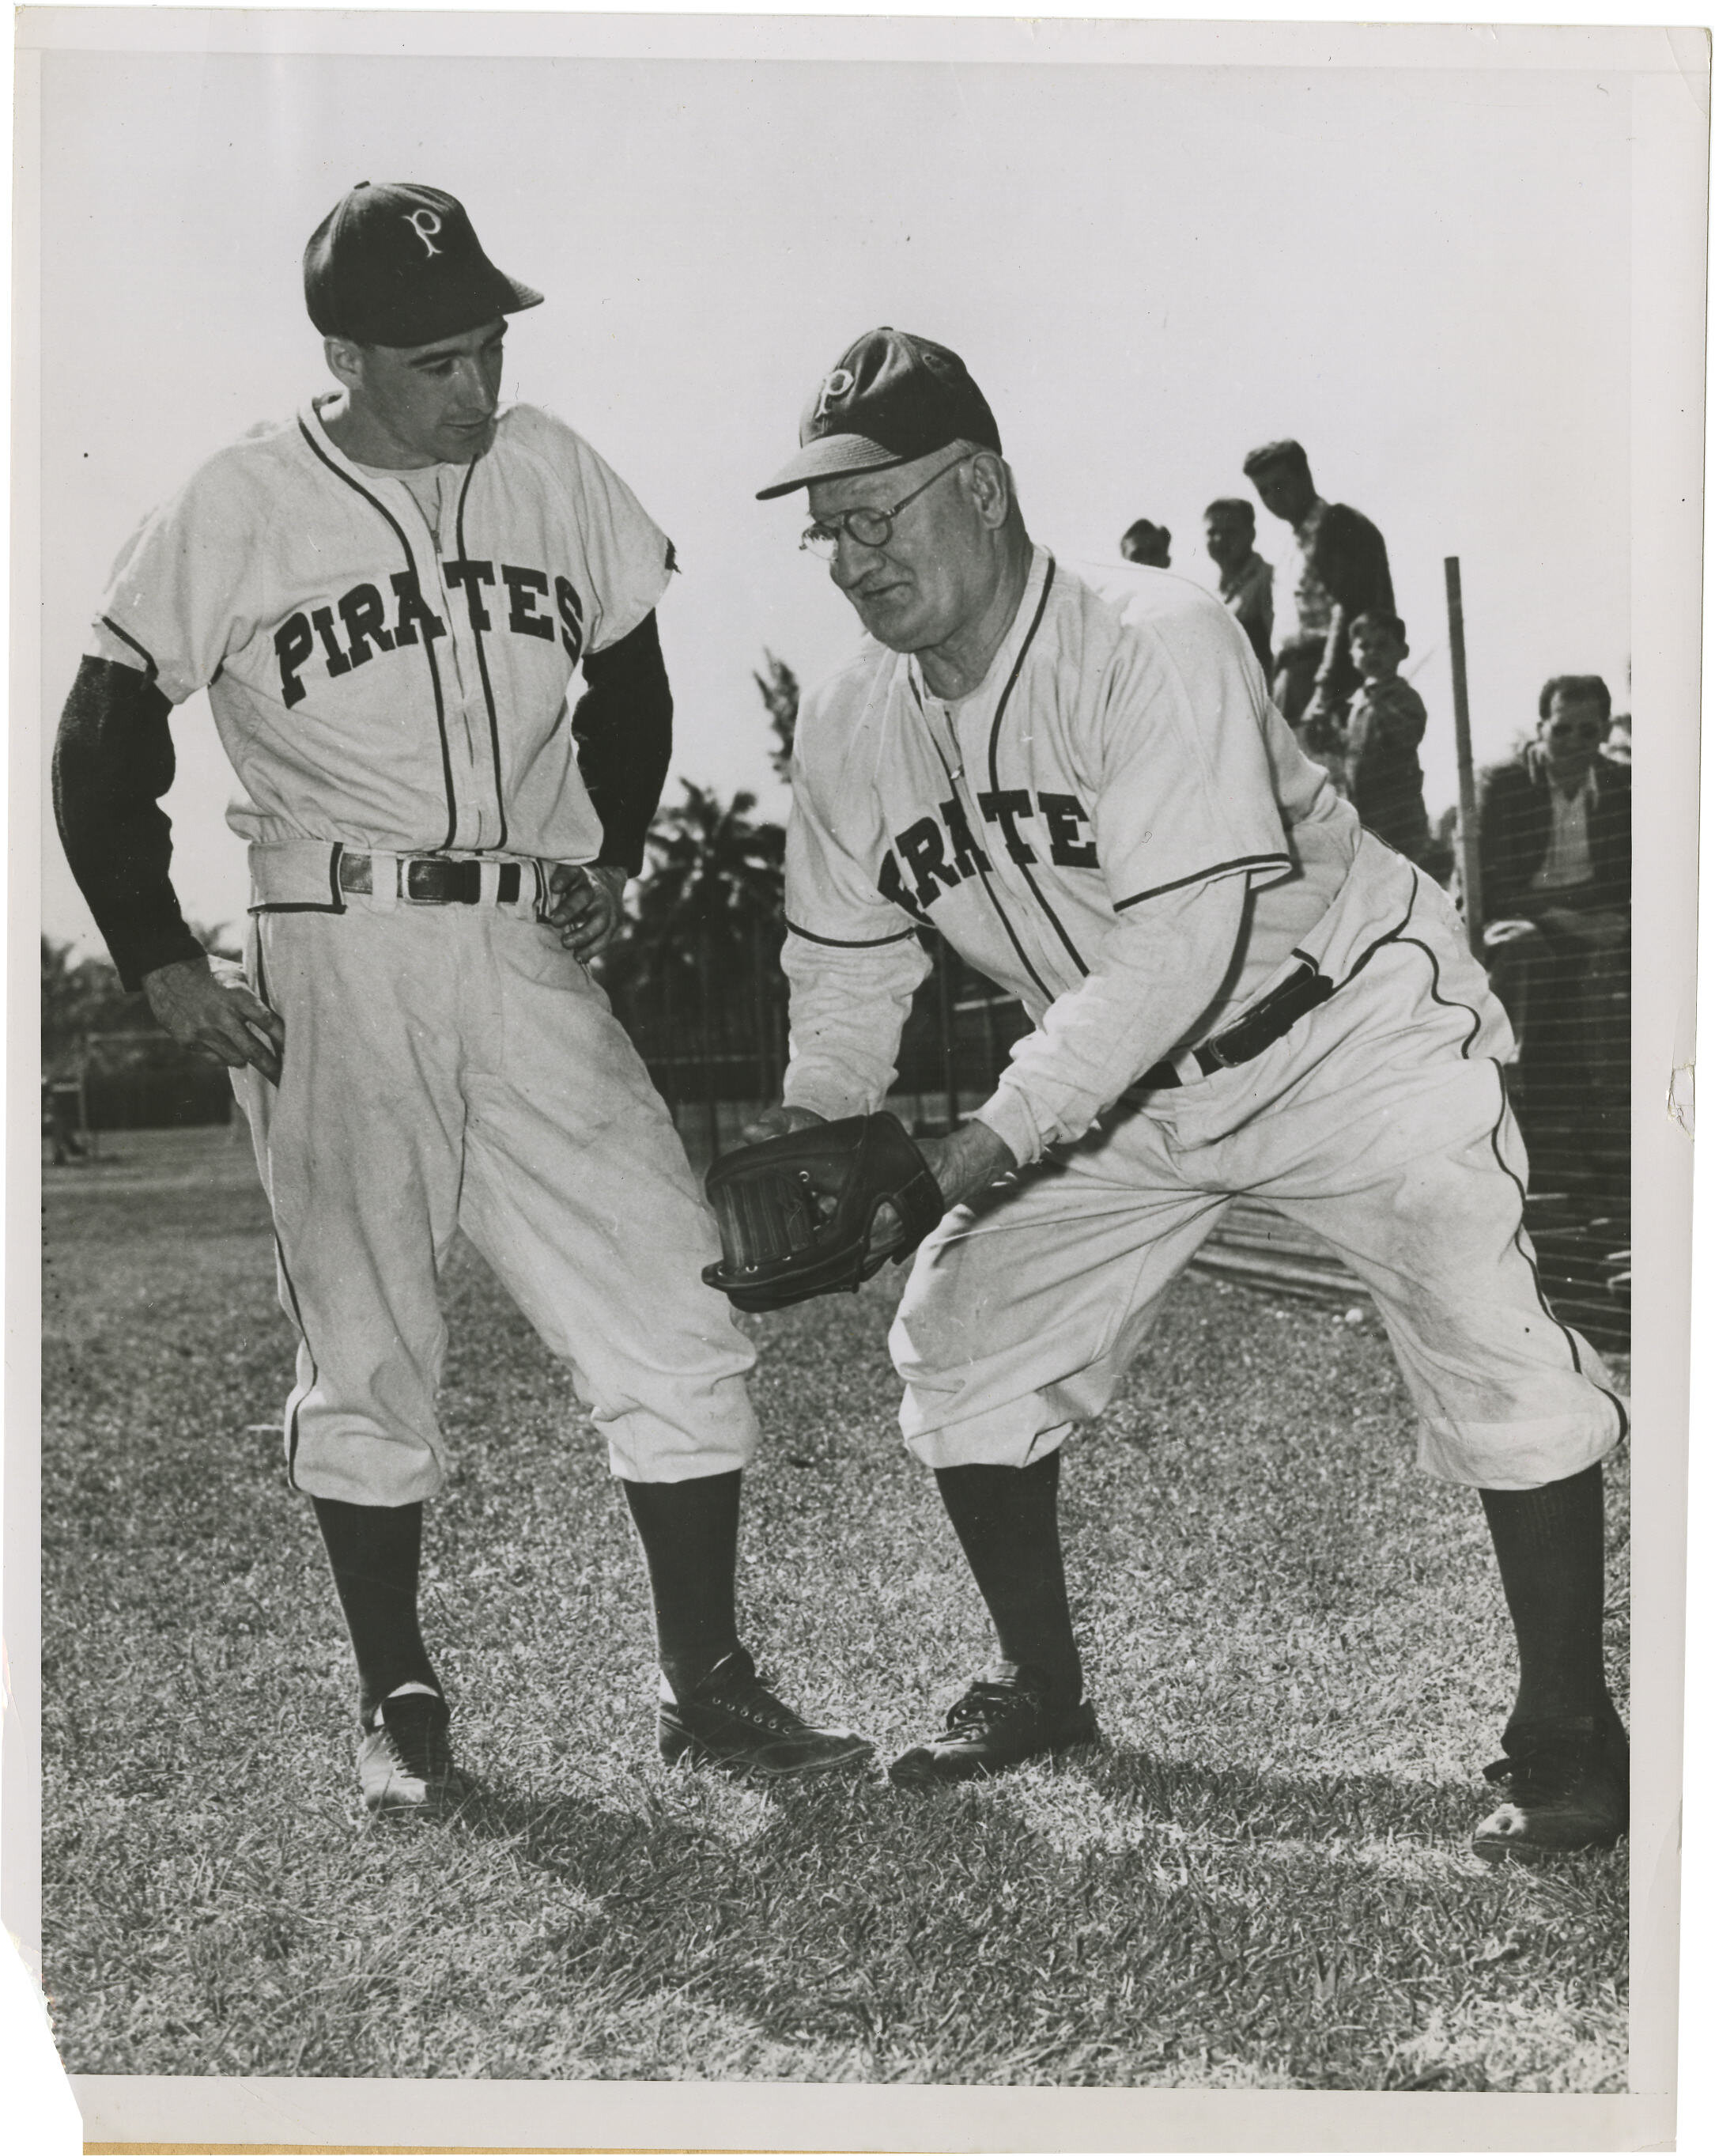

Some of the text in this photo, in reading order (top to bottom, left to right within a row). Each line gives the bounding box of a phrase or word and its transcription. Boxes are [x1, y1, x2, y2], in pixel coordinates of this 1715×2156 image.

[402, 209, 443, 258] P
[812, 369, 854, 419] P
[274, 560, 584, 709] PIRATES
